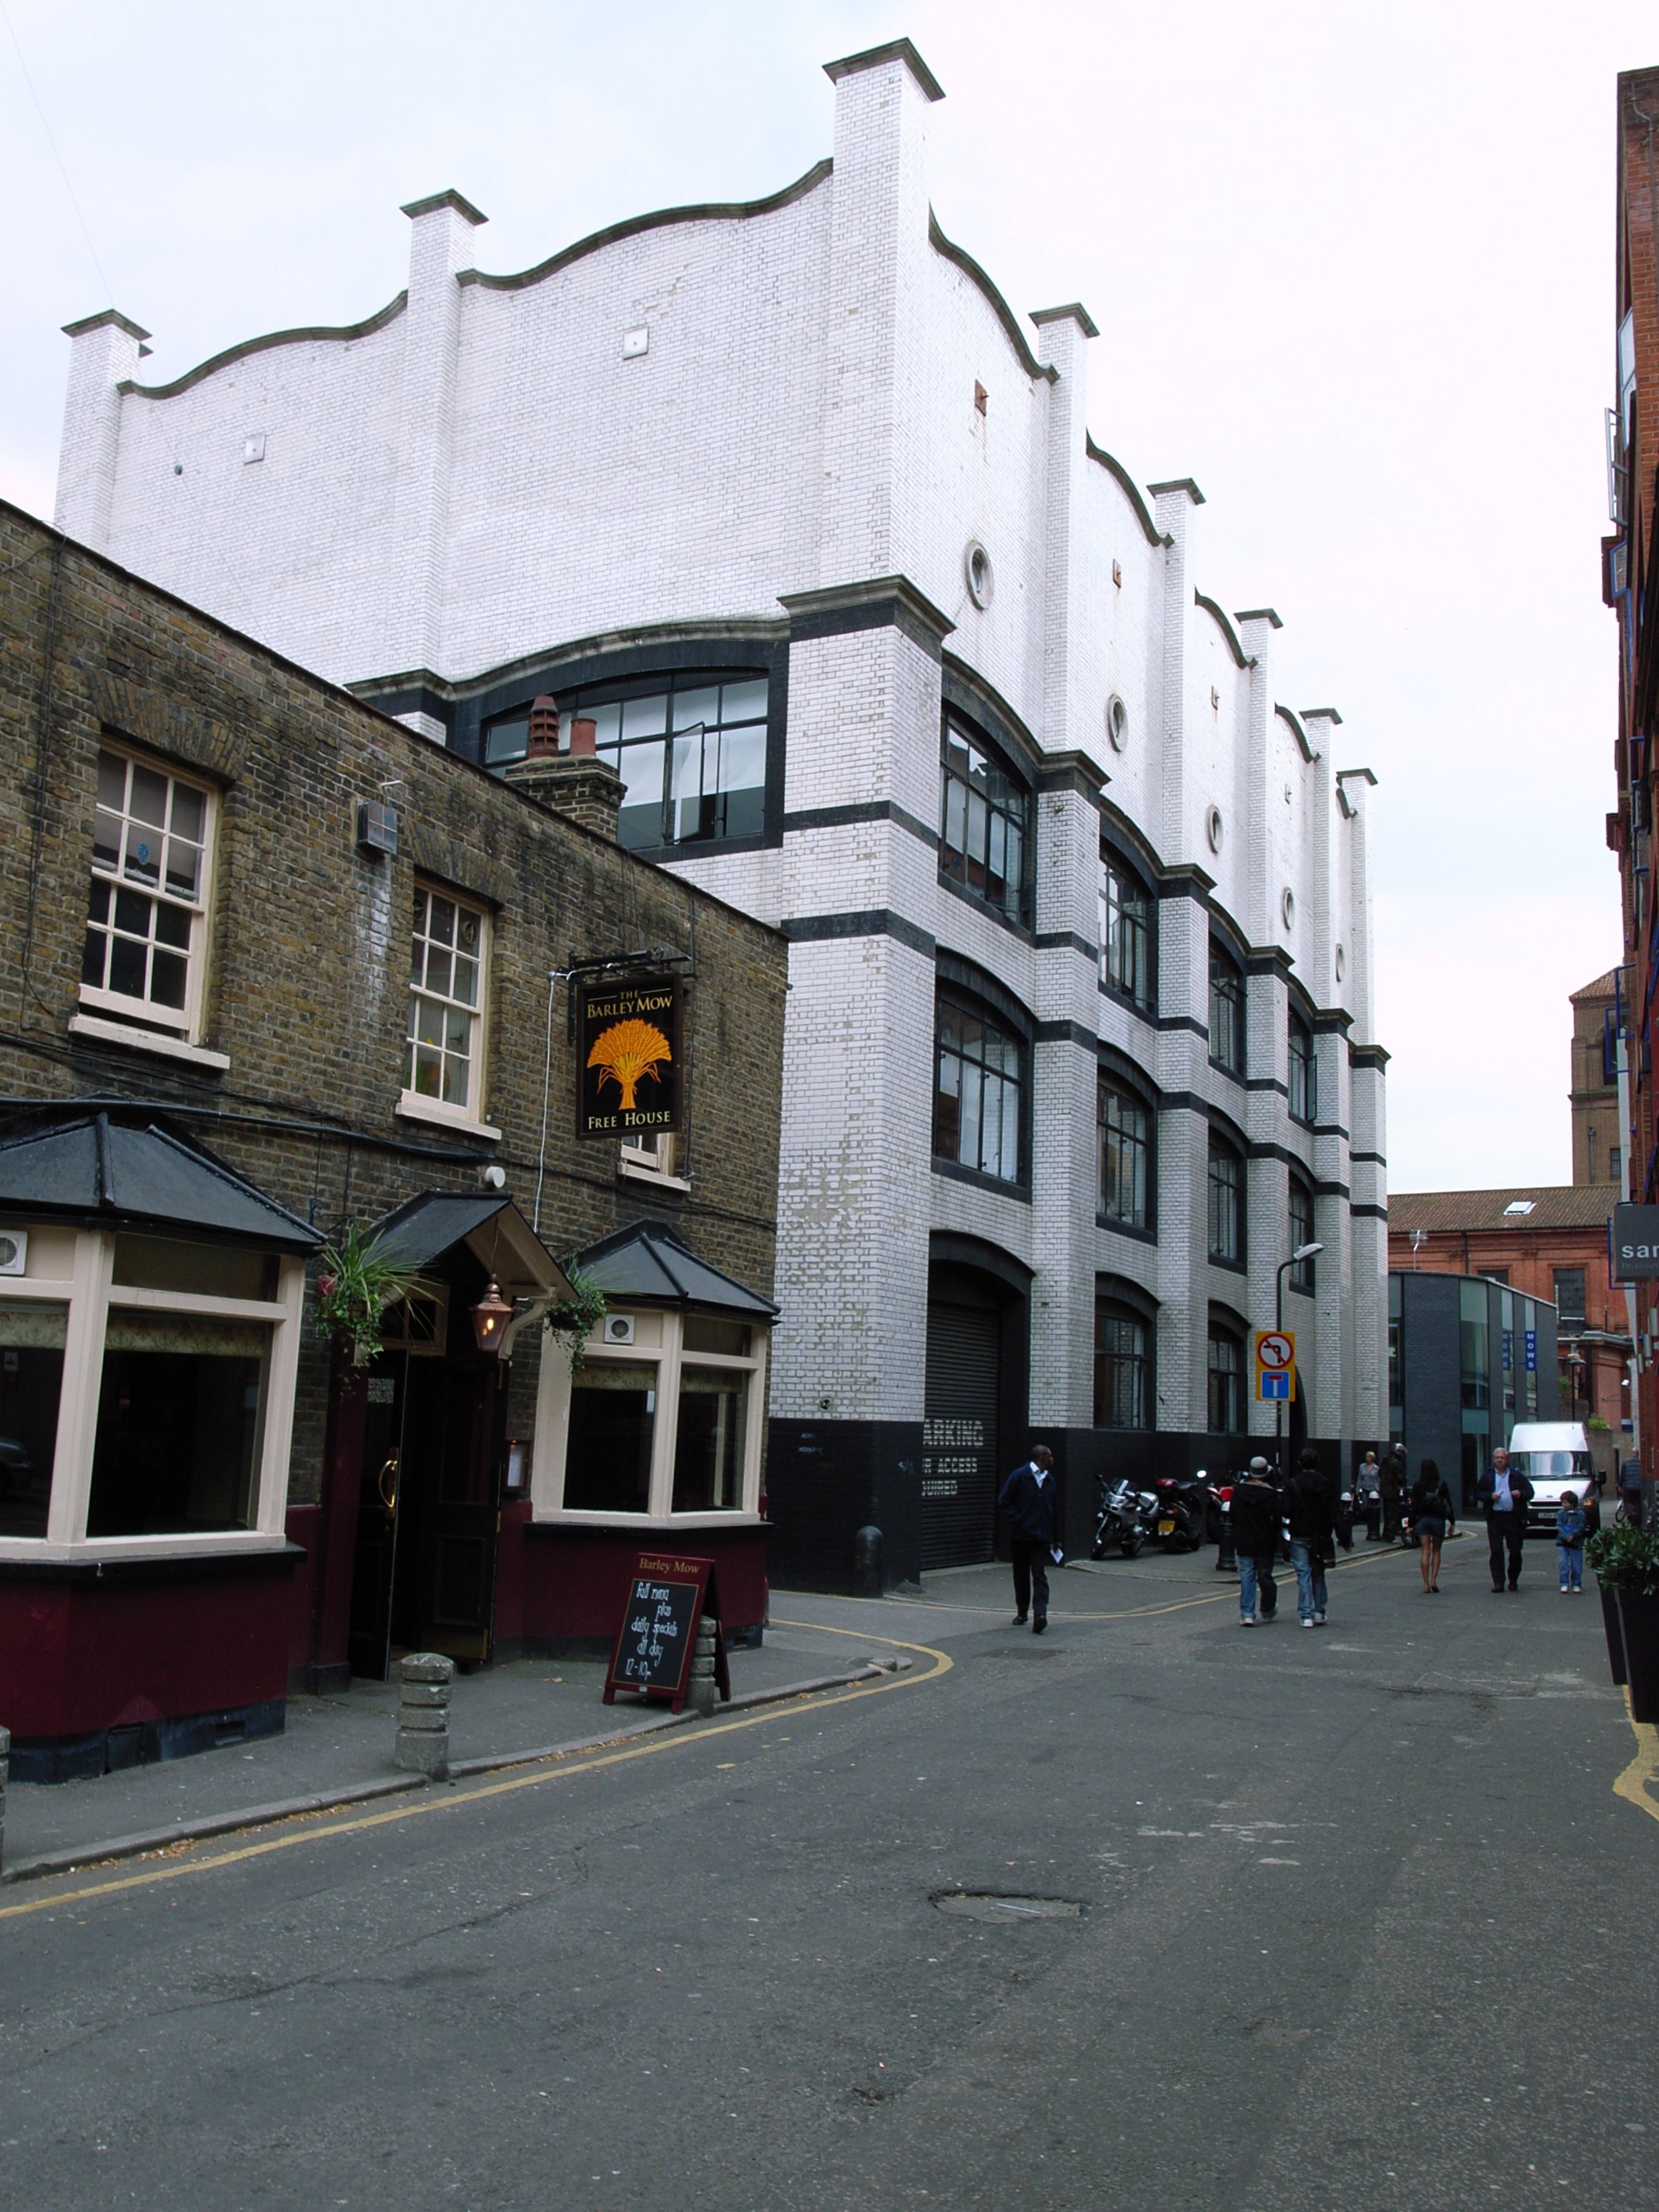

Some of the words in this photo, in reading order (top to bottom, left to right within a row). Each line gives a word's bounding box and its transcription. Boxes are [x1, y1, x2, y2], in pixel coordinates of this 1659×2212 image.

[619, 989, 639, 1000] THE
[587, 1001, 635, 1018] BARLEY
[637, 995, 673, 1011] MOW
[588, 1116, 618, 1129] FREE
[625, 1111, 670, 1126] HOUSE
[923, 1419, 984, 1447] ARKING
[937, 1457, 978, 1473] ACCESS
[639, 1558, 671, 1574] Barley
[673, 1561, 700, 1574] Mow
